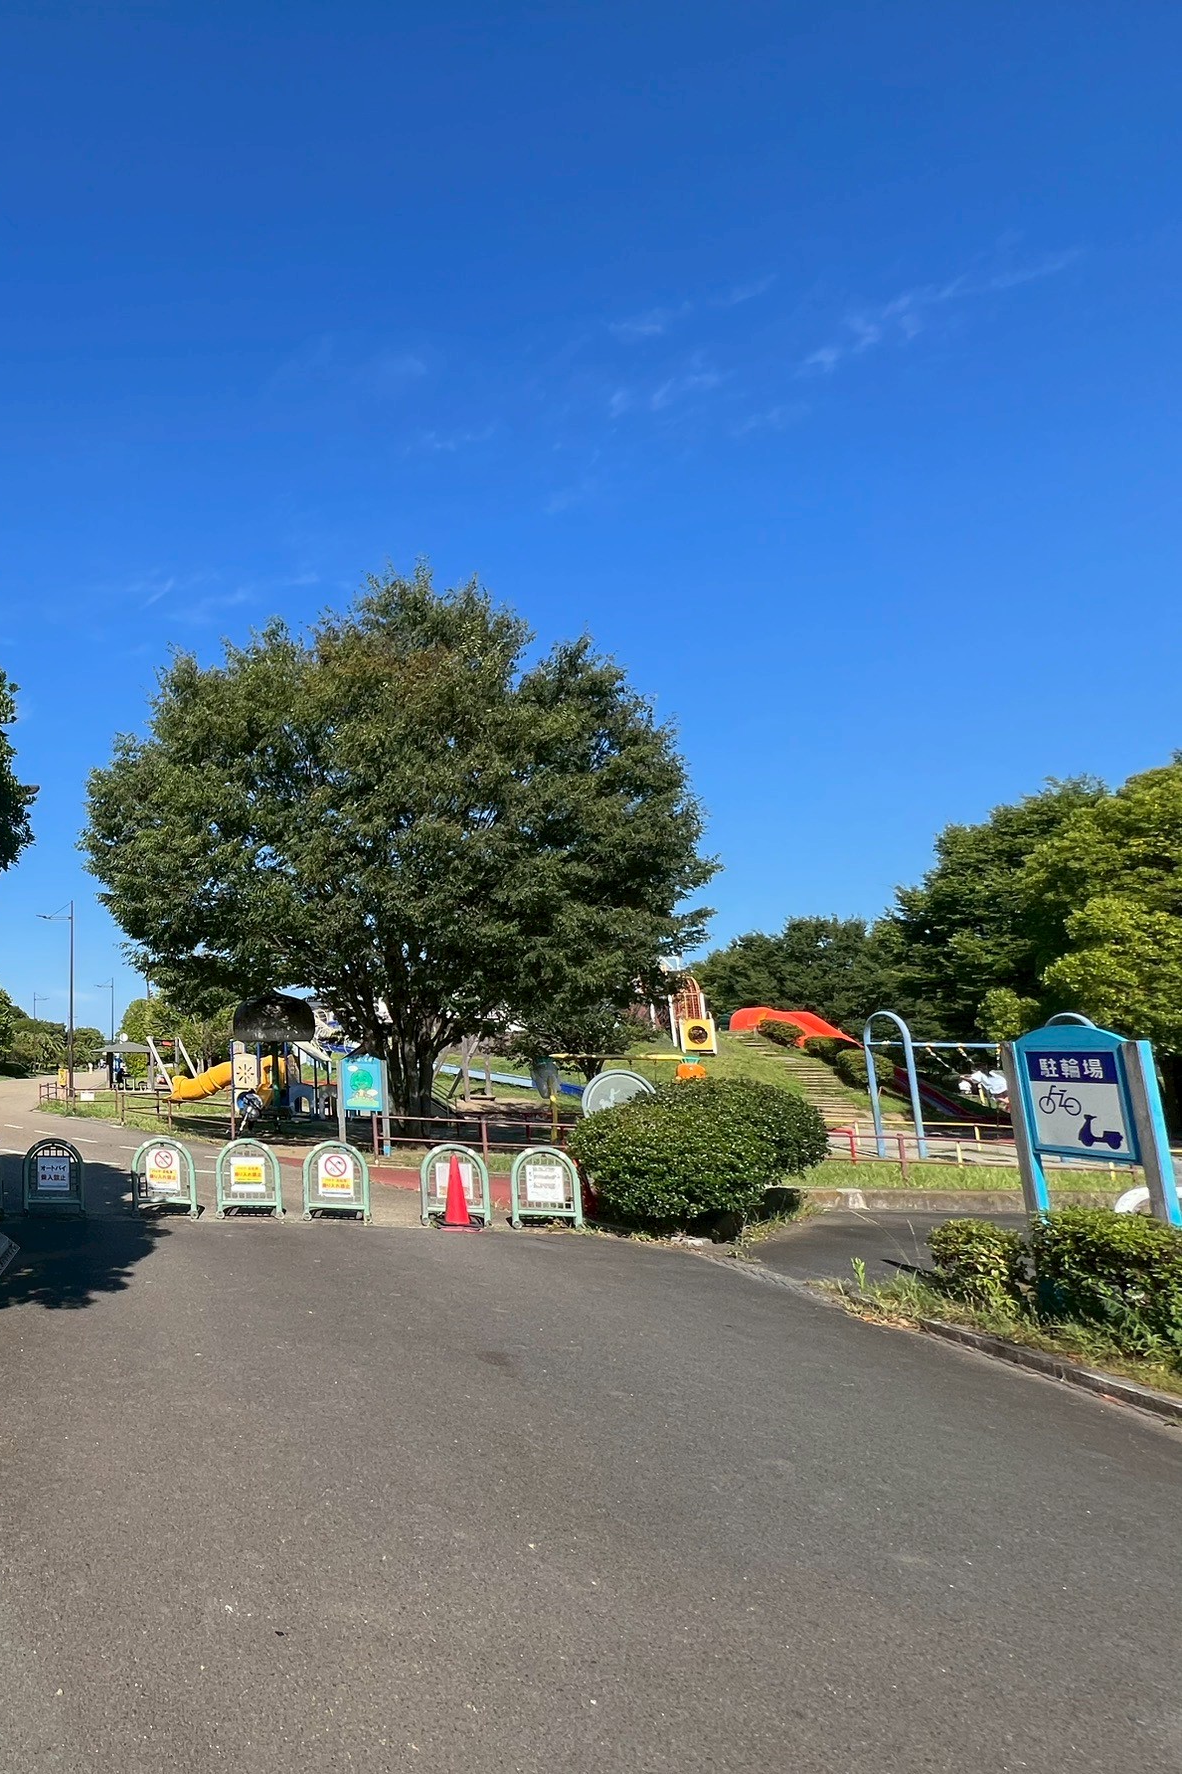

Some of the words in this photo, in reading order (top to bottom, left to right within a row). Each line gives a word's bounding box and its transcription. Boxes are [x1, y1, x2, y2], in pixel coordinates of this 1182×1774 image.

[1038, 1057, 1104, 1080] 駐輪場
[40, 1164, 67, 1172] オートバイ
